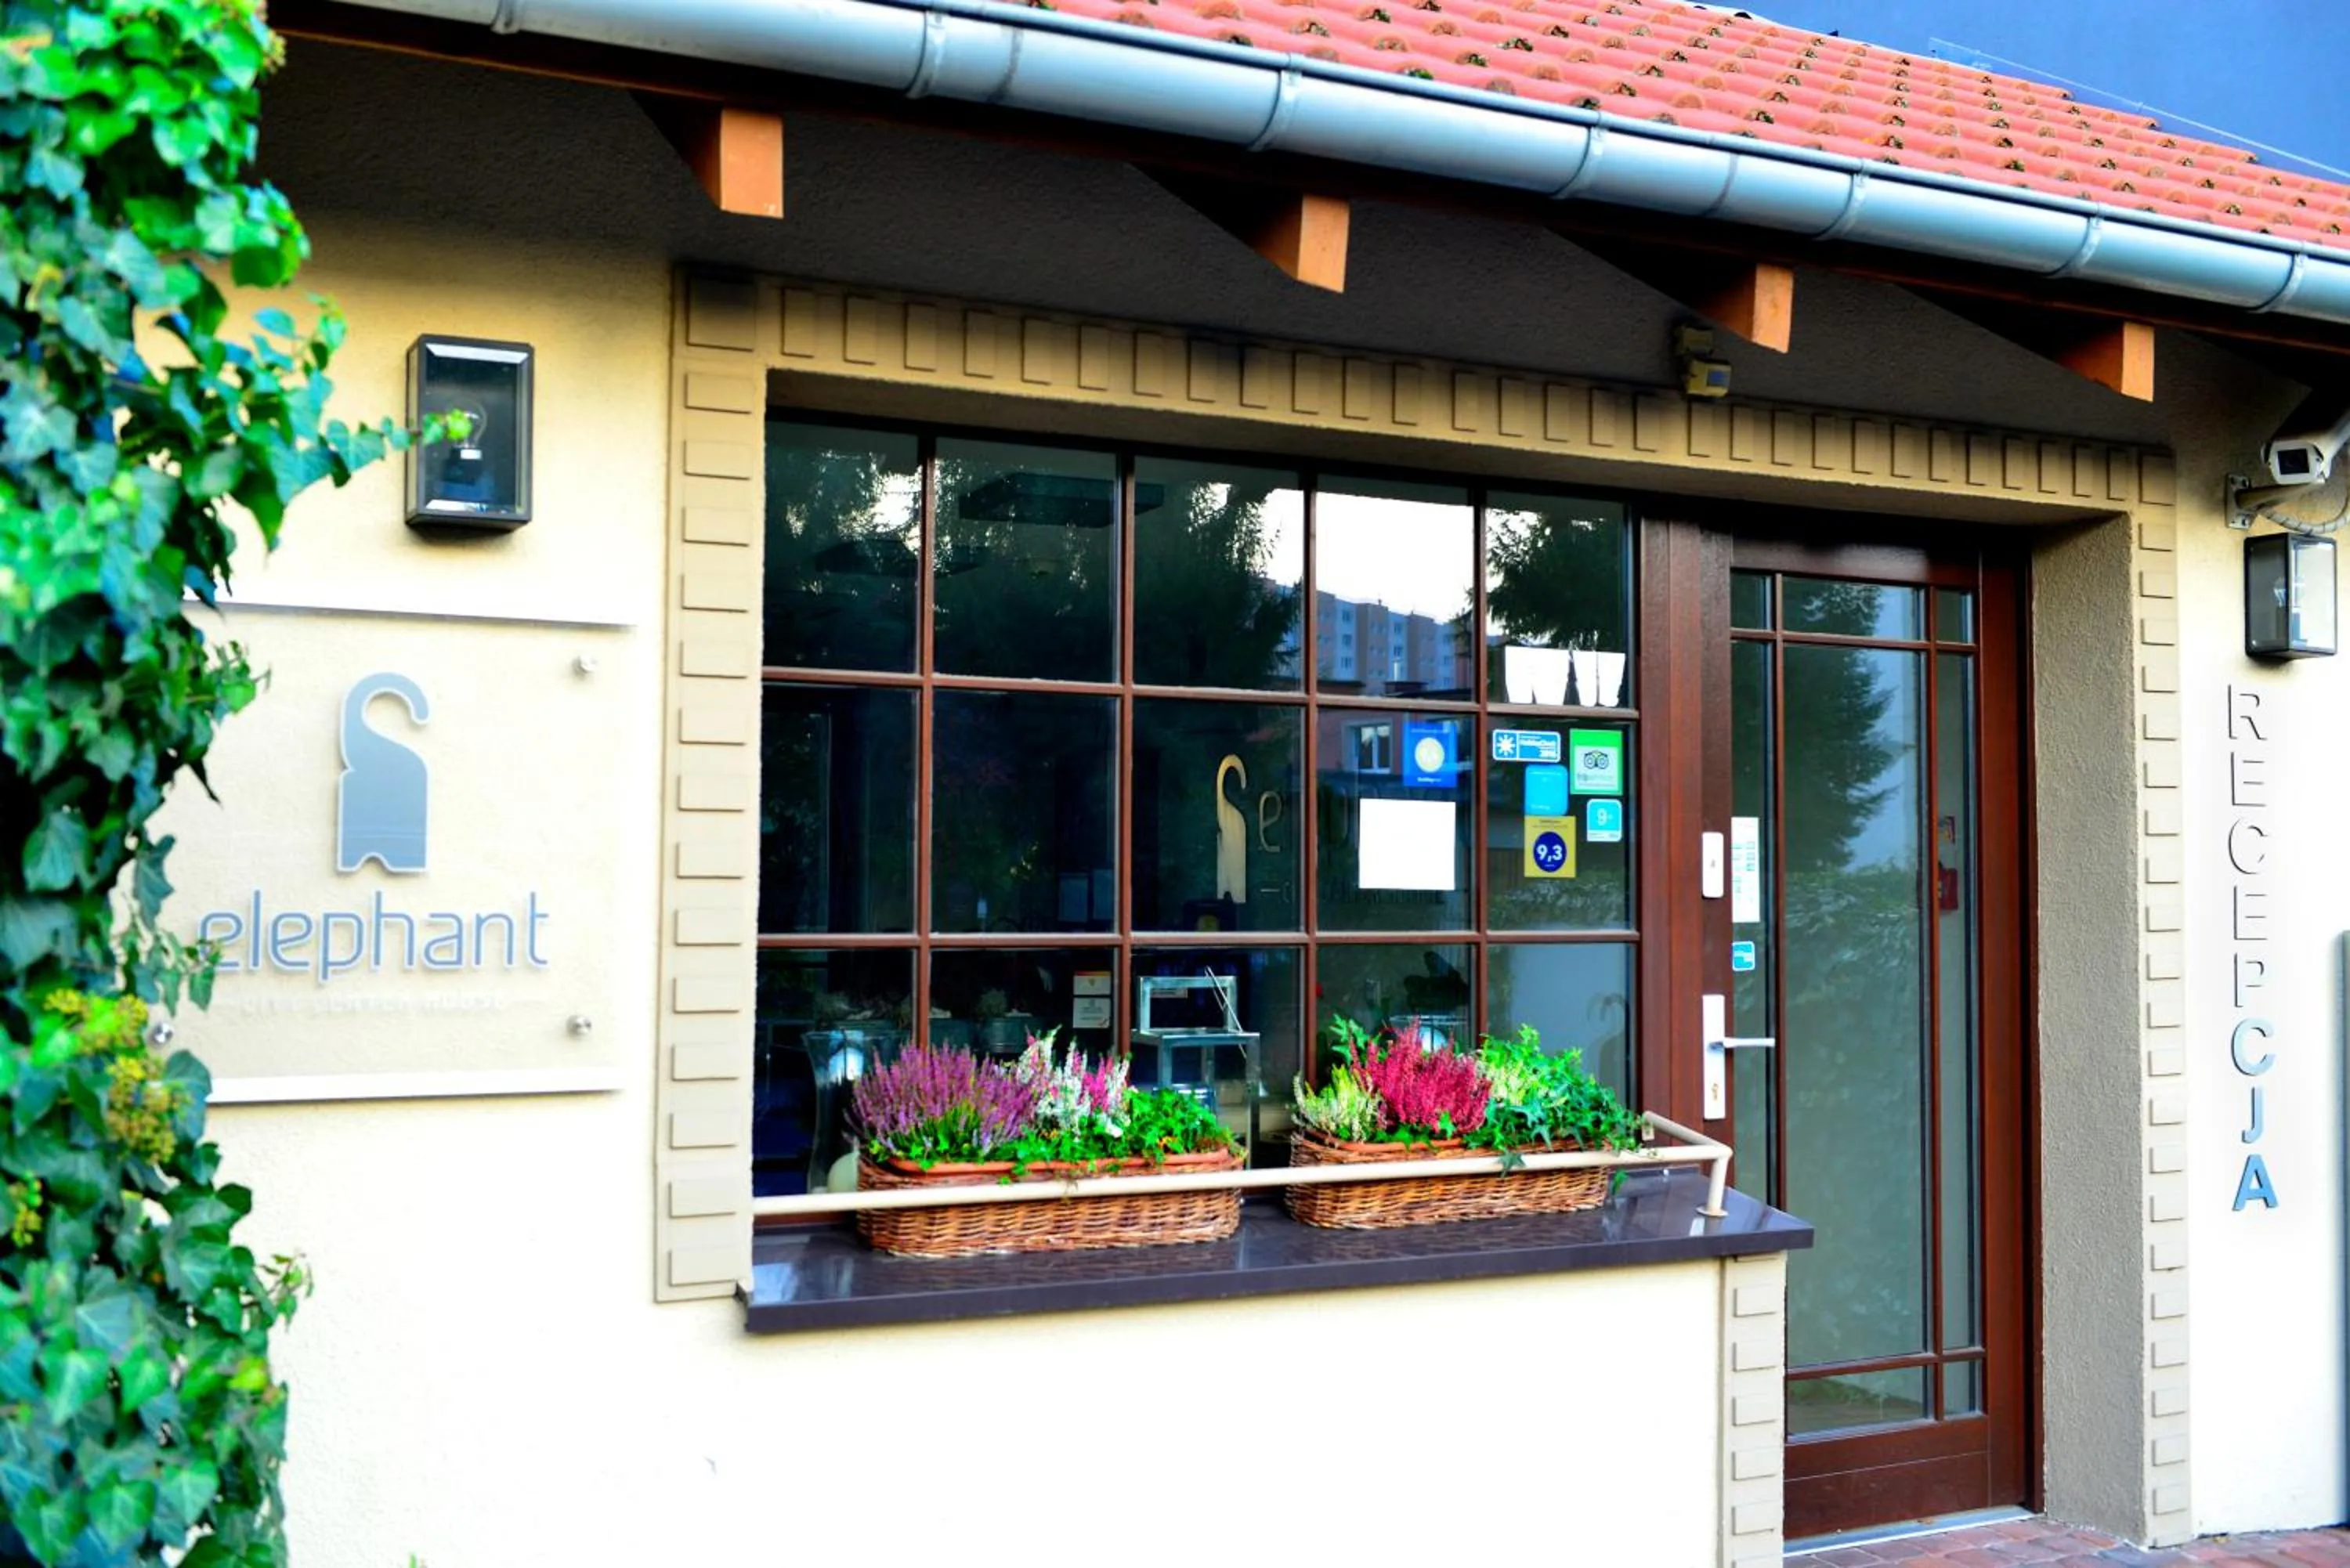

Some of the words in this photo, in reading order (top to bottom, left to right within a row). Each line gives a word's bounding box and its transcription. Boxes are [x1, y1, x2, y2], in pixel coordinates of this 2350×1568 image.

[1537, 844, 1563, 862] 9,3
[198, 888, 550, 983] elephant
[2226, 683, 2279, 1212] RECEPCJA
